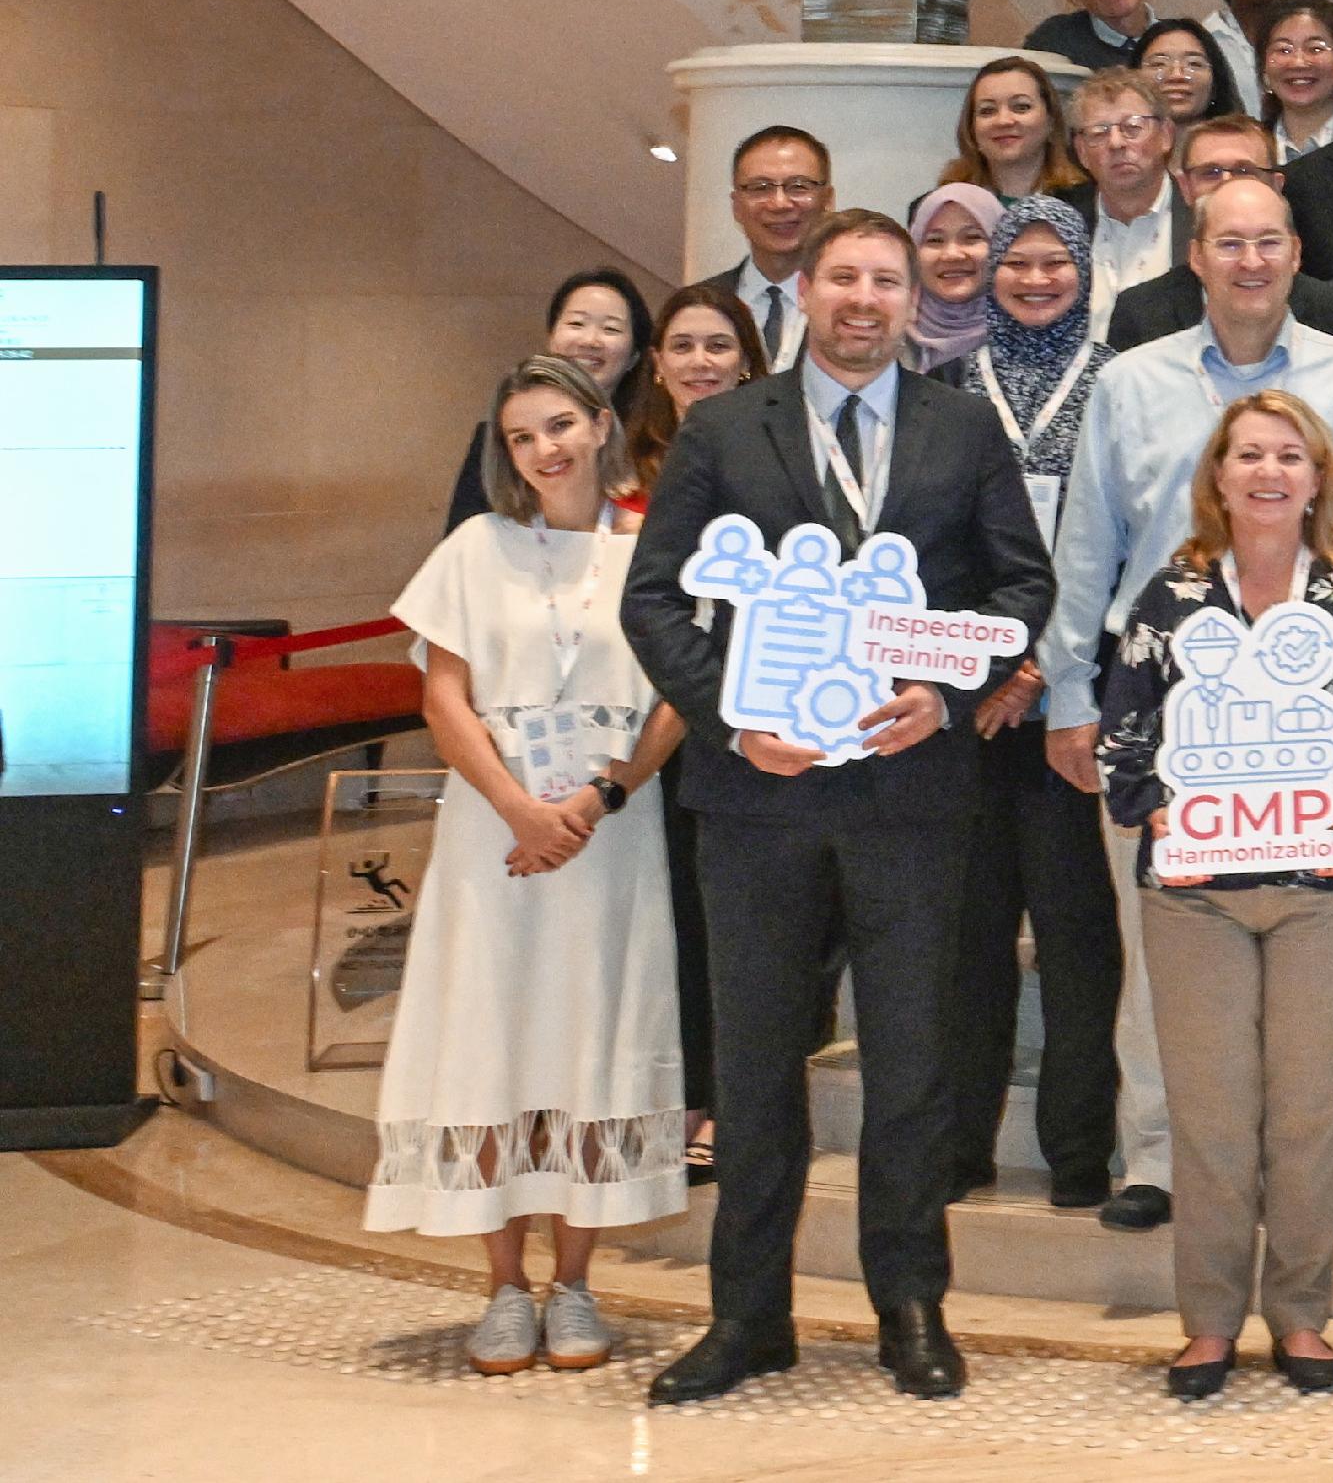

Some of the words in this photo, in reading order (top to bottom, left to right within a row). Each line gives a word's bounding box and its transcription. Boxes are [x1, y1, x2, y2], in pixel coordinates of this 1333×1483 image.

[867, 609, 1017, 645] Inspectors
[864, 641, 979, 676] Training
[1180, 789, 1331, 841] GMP
